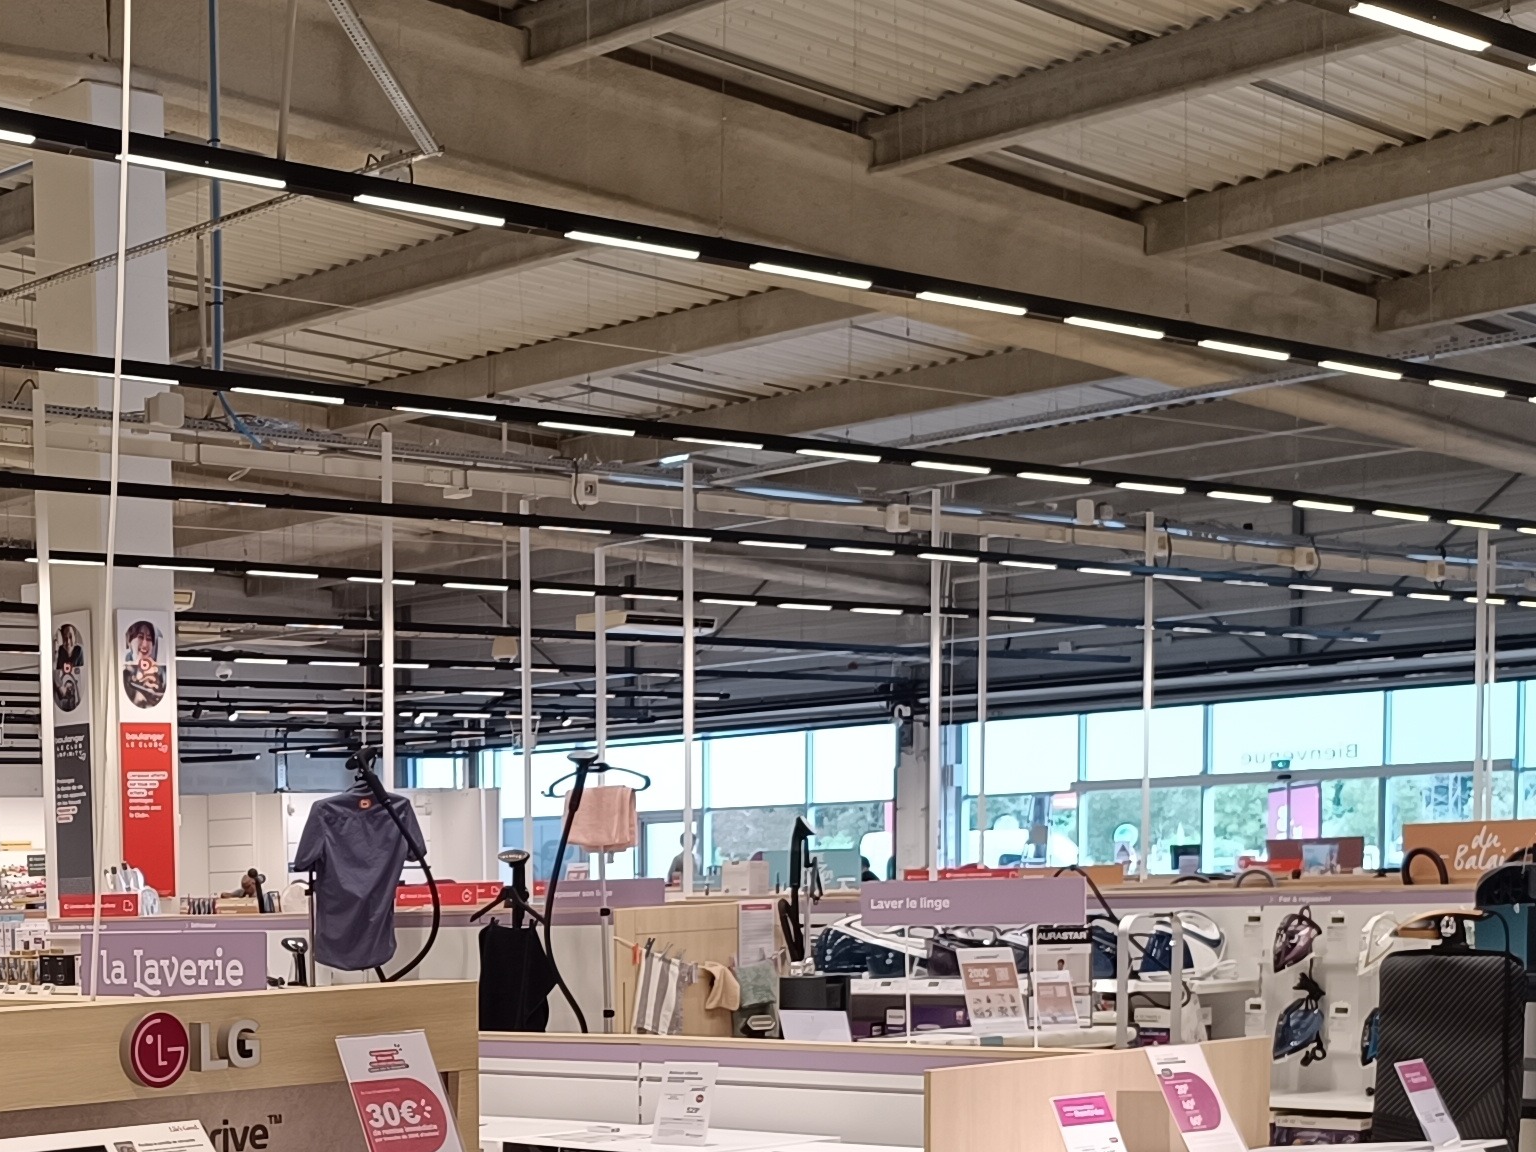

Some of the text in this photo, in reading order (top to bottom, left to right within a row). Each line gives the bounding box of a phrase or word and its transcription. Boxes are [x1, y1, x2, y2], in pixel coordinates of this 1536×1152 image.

[1472, 825, 1501, 850] du
[870, 896, 950, 910] Laver le linge
[1037, 927, 1088, 941] AURASTAR
[100, 948, 244, 996] la Laverie
[196, 1018, 262, 1072] LG
[365, 1100, 421, 1128] 30€
